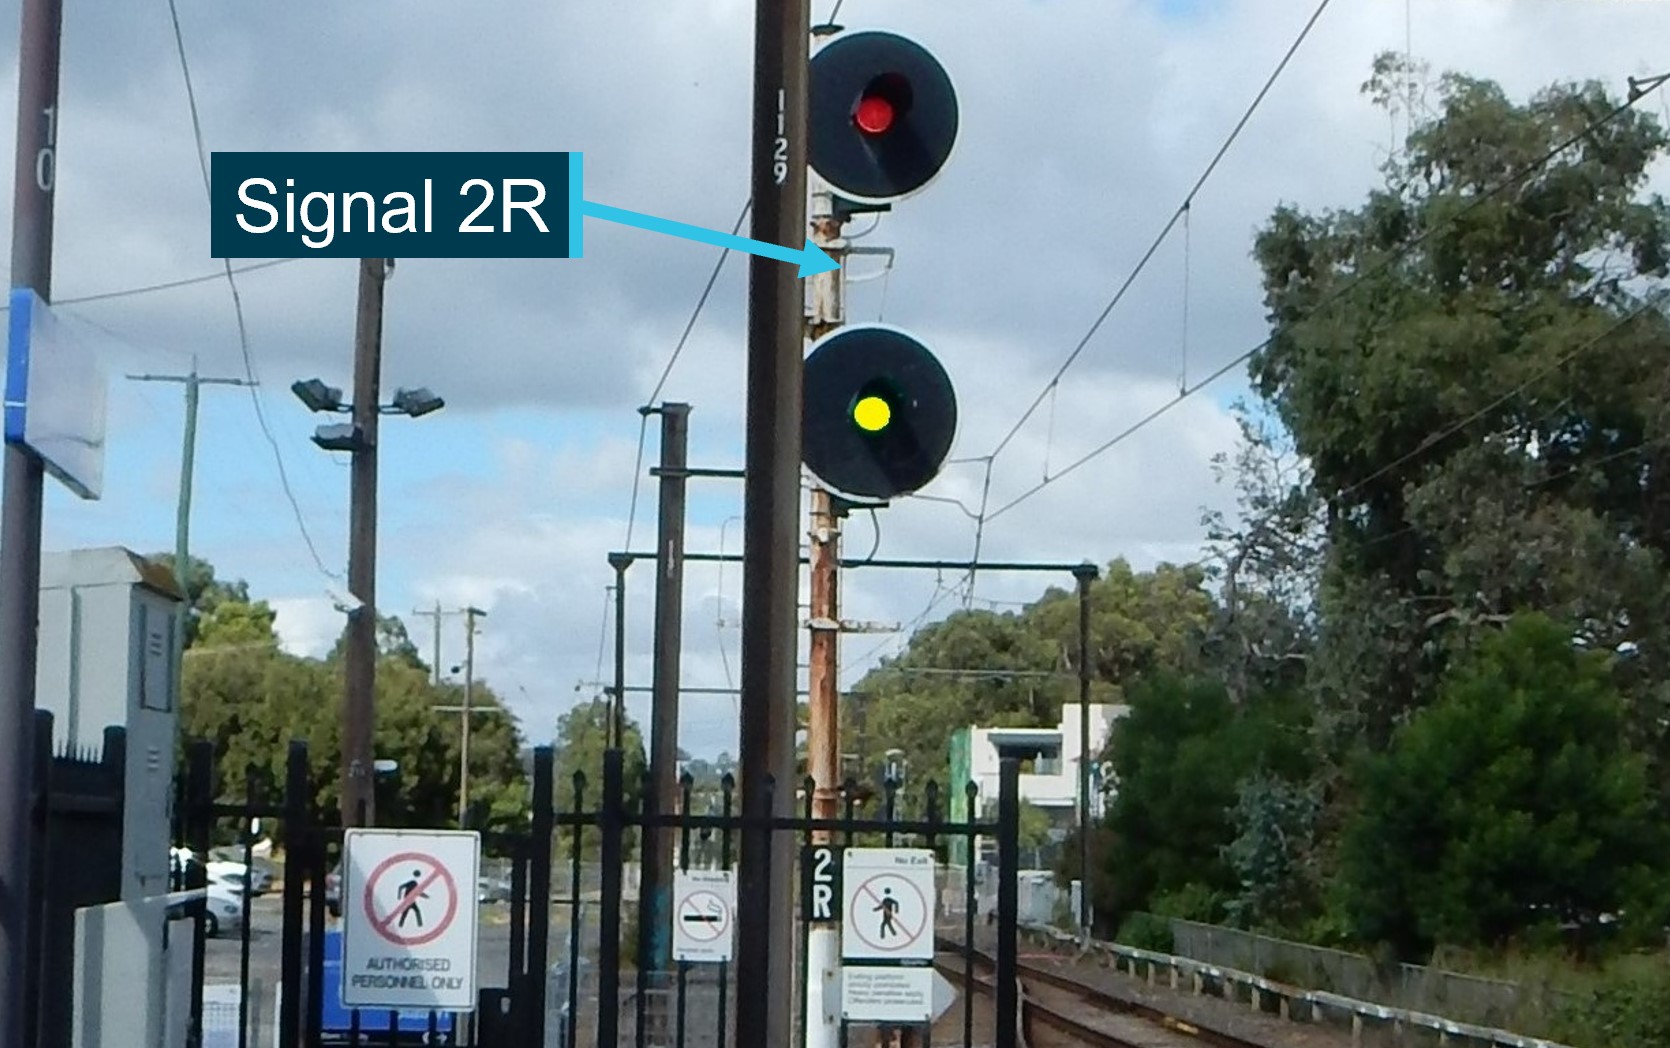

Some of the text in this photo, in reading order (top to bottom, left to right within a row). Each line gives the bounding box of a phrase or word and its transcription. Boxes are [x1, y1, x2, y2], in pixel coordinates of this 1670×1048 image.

[36, 104, 54, 191] 10
[773, 88, 788, 184] 1129
[351, 974, 464, 990] PERSONNEL ONLY
[366, 957, 452, 972] AUTHORISED
